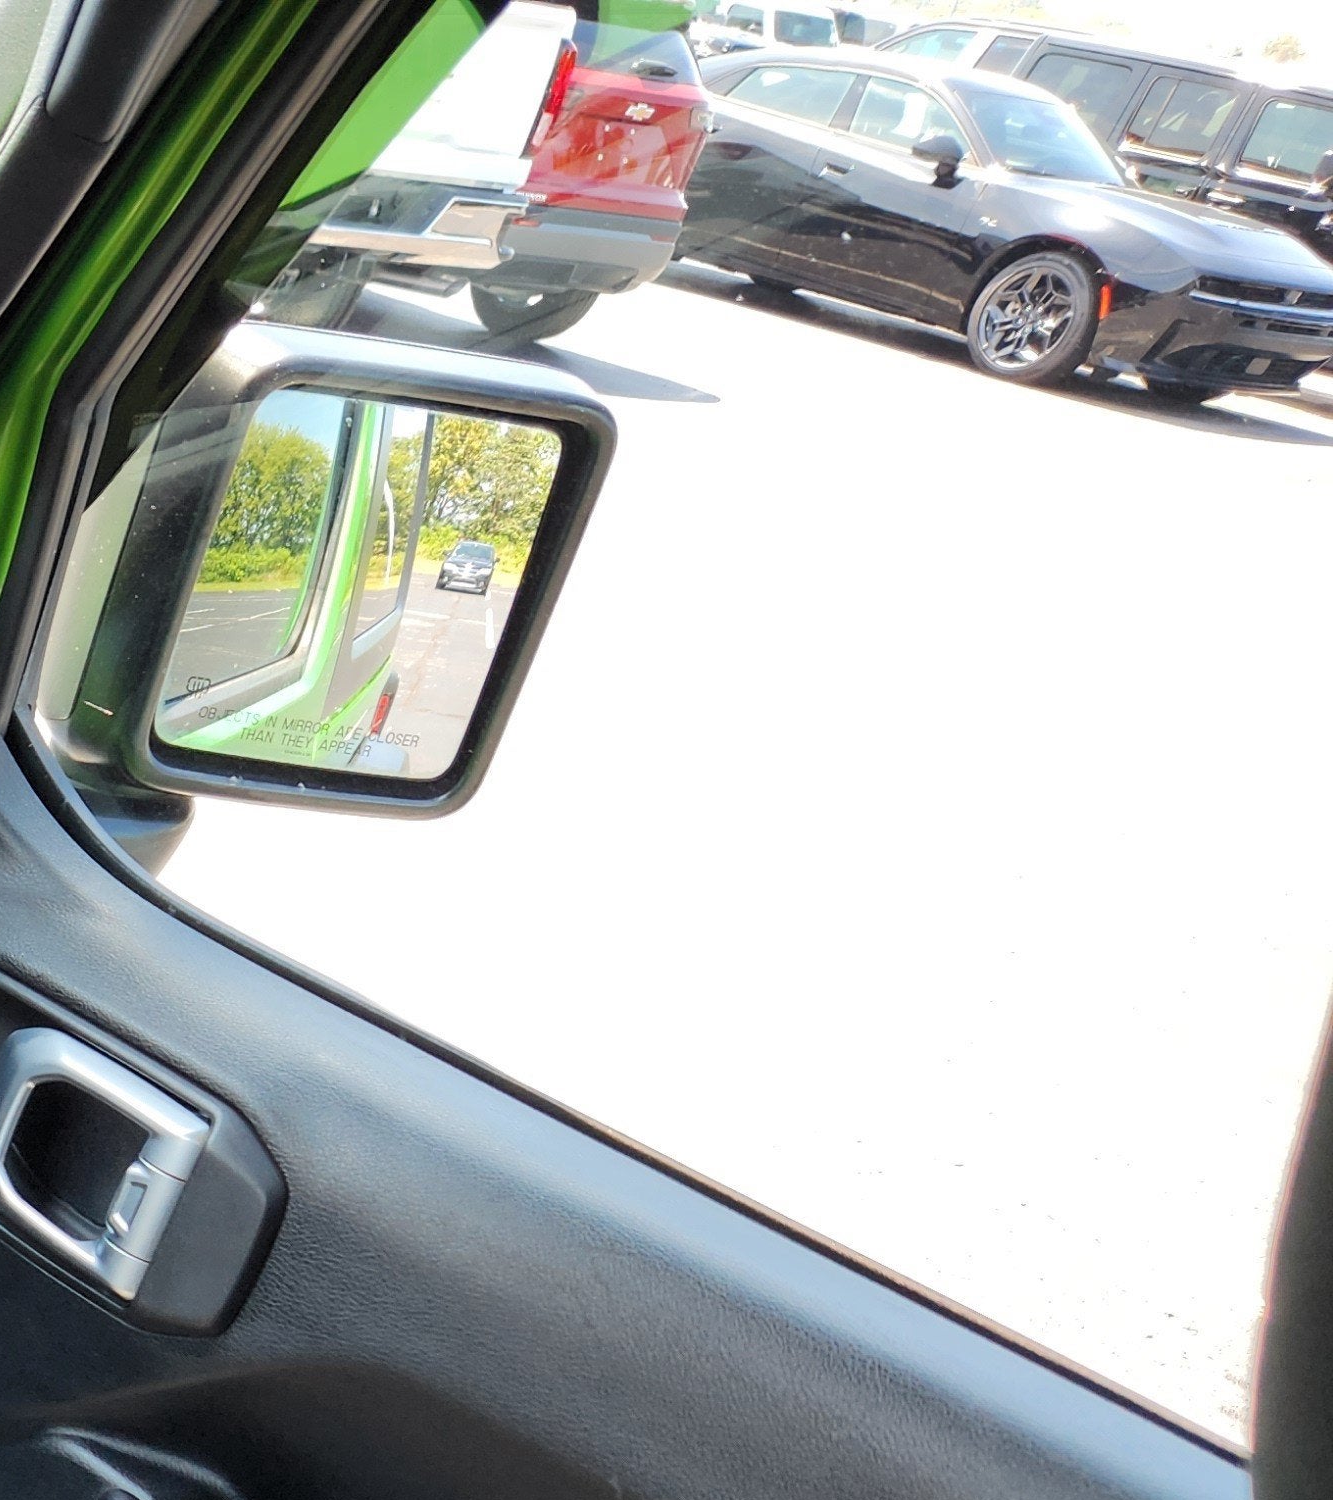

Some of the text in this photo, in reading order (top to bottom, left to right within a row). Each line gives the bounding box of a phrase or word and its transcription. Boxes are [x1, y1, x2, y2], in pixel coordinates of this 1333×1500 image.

[198, 706, 421, 748] OBJECTS IN MIRROR ARE CLOSER
[239, 727, 274, 743] THAN
[282, 734, 312, 749] THEY
[318, 738, 372, 757] APPEAR
